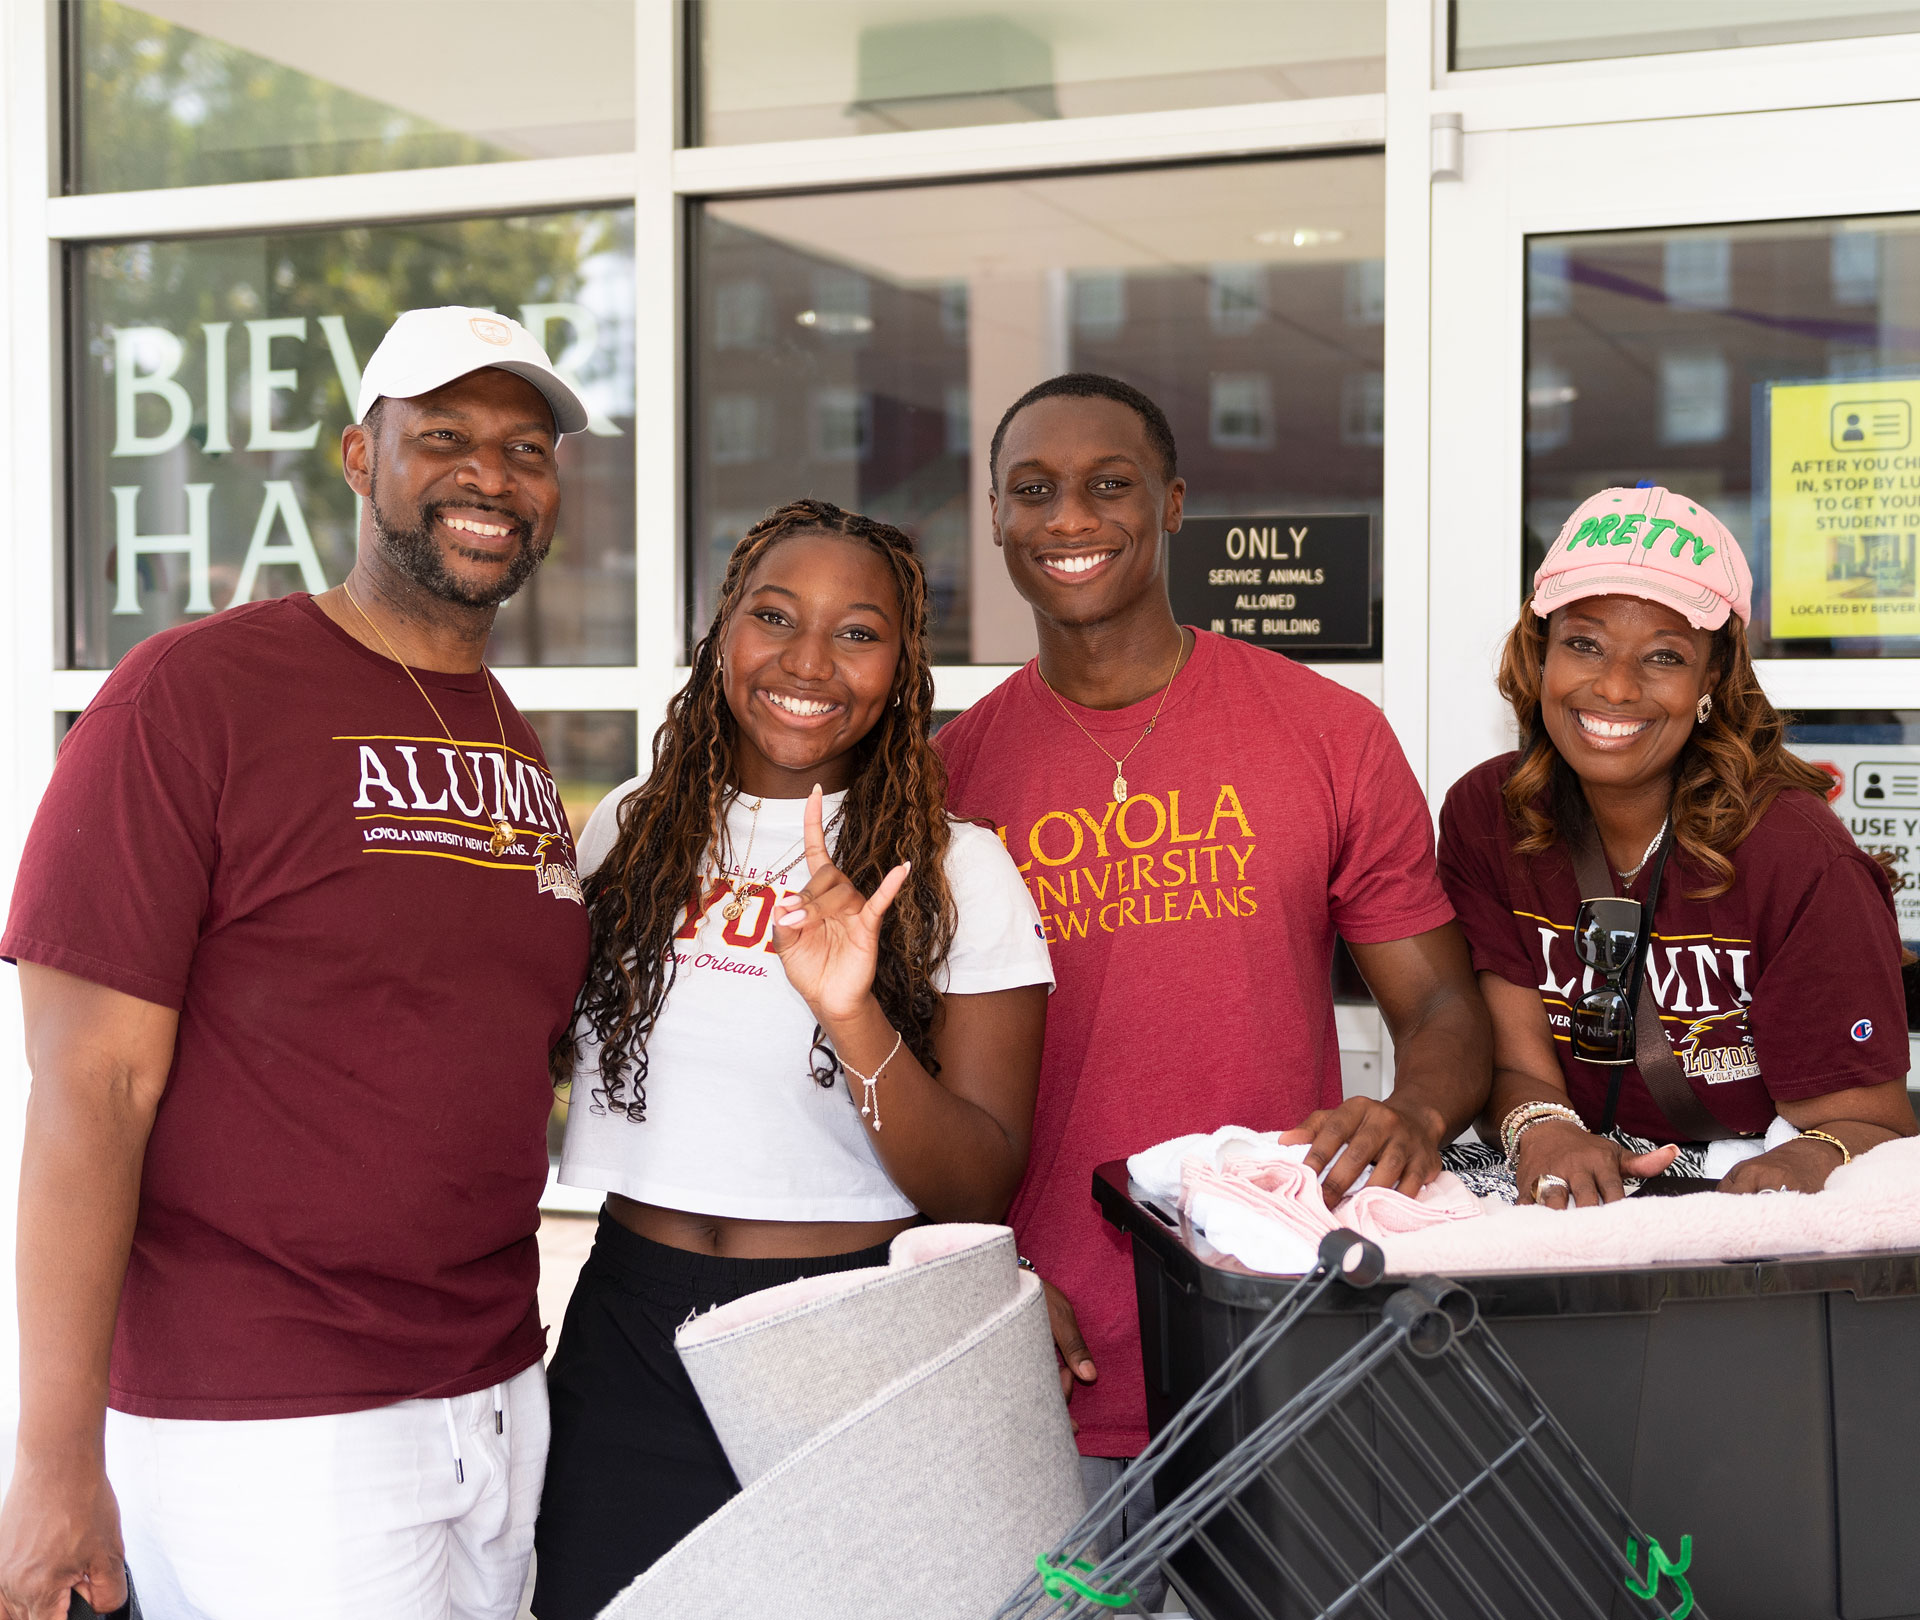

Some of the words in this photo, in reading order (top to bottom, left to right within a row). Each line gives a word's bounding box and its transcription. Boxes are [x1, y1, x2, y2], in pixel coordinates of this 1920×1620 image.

[111, 302, 625, 457] BIEVR
[1791, 459, 1848, 474] AFTER
[1852, 457, 1889, 472] YOU
[1893, 456, 1920, 470] CH
[1796, 480, 1819, 493] IN,
[1823, 477, 1869, 492] STOP
[1873, 475, 1896, 490] BY
[1813, 497, 1838, 511] TO
[1842, 495, 1875, 510] GET
[1879, 494, 1920, 509] YOU
[1817, 513, 1900, 531] STUDENT
[1227, 526, 1309, 561] ONLY
[1567, 513, 1716, 566] PRETTY
[1208, 569, 1262, 585] SERVICE
[1267, 568, 1326, 585] ANIMALS
[1235, 594, 1296, 610] ALLOWED
[1790, 604, 1849, 616] LOCATED
[1852, 604, 1868, 615] BY
[1211, 618, 1225, 634] IN
[1230, 618, 1256, 634] THE
[1262, 618, 1321, 635] BUILDING
[1850, 817, 1897, 837] USE
[363, 826, 411, 842] LOYOLA
[410, 829, 464, 847] UNIVERSITY
[464, 837, 483, 851] NEW
[1041, 907, 1091, 945] EW
[664, 951, 692, 966] ew
